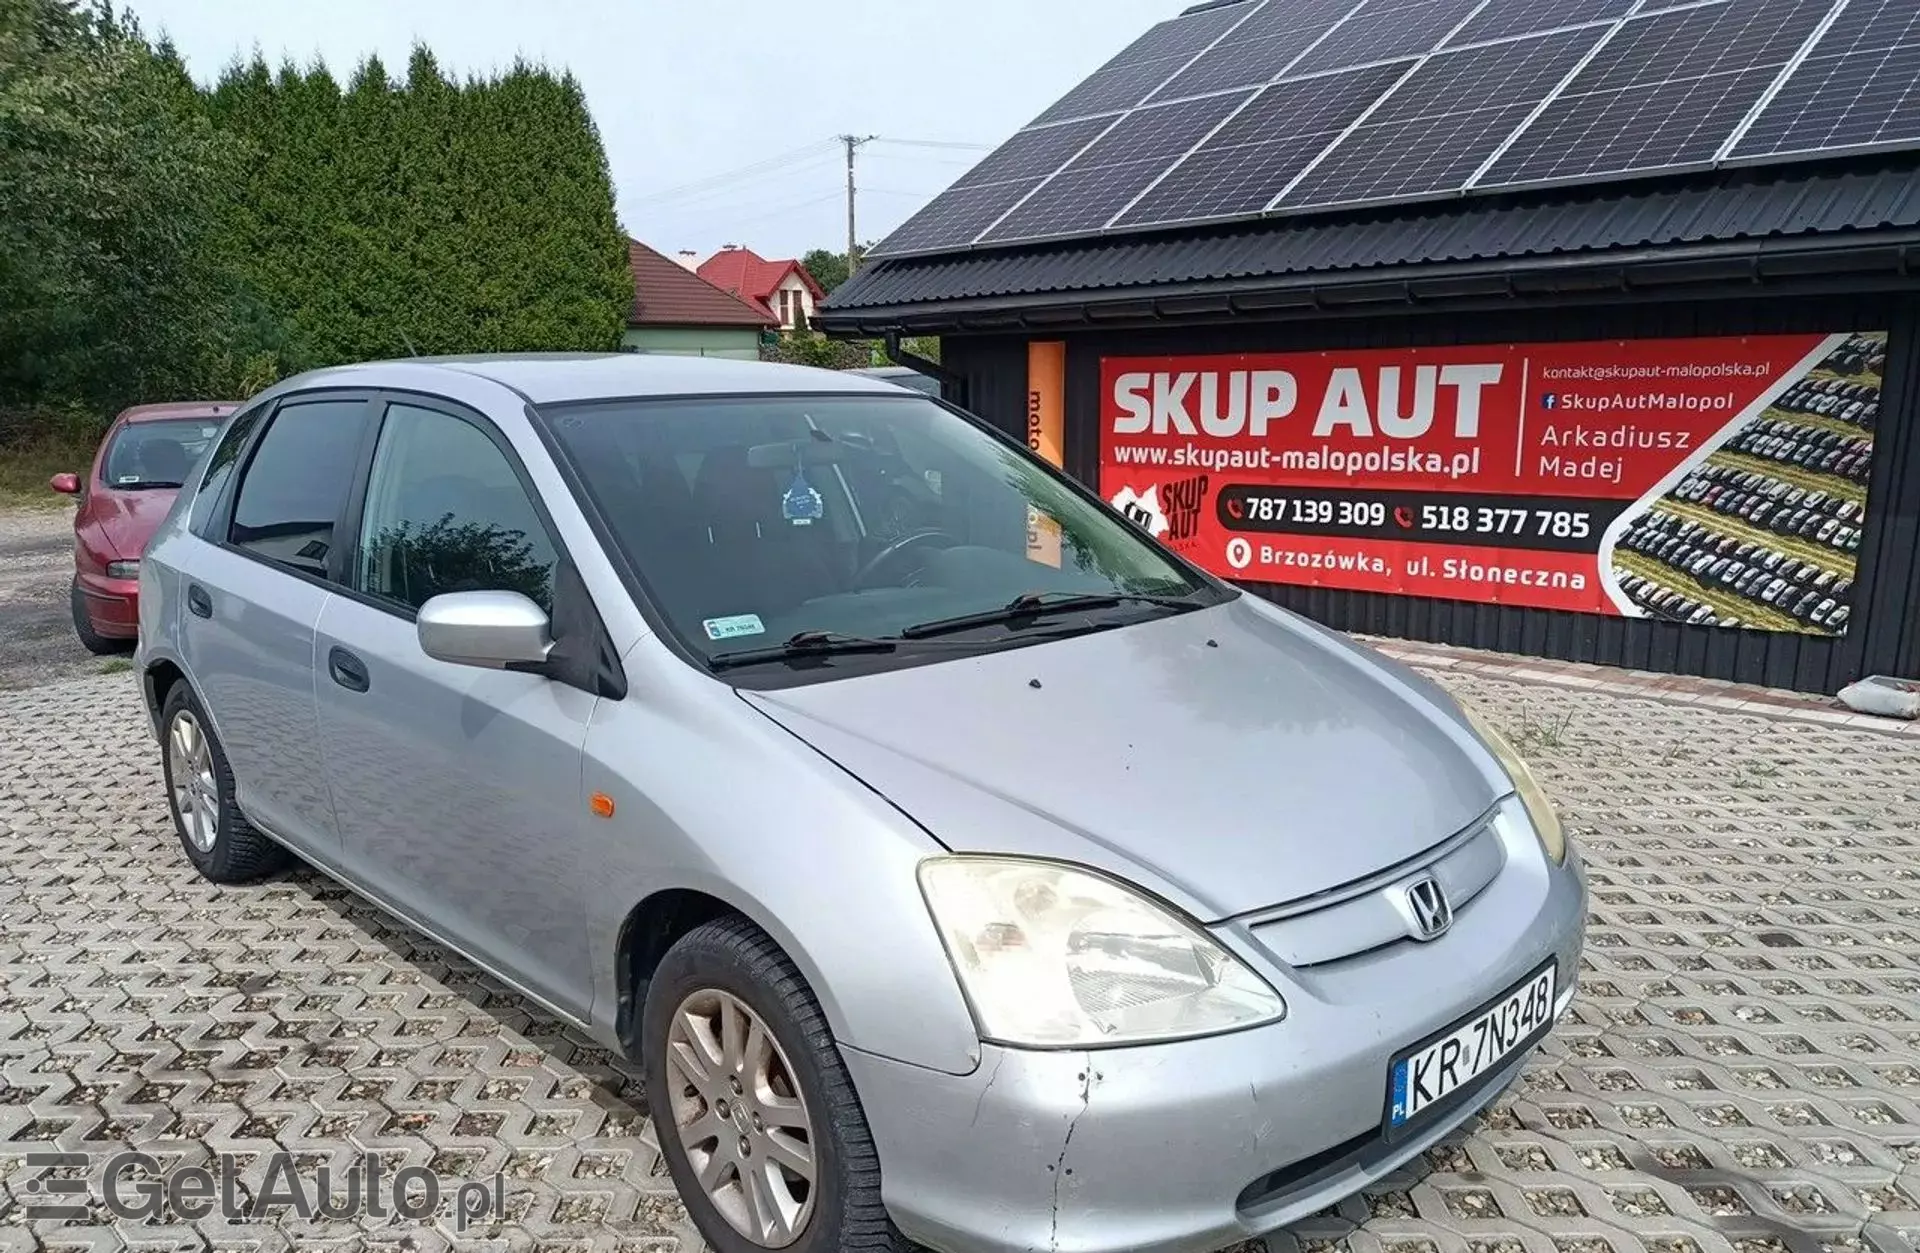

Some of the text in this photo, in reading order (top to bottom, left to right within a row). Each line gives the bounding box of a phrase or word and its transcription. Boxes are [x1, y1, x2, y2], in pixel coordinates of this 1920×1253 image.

[1543, 362, 1770, 381] kontakt@skupaut-malopolska.pl
[1113, 363, 1504, 438] SKUP AUT
[1561, 392, 1734, 412] SkupAutMalopol
[1541, 424, 1690, 449] Arkadiusz
[1114, 443, 1480, 479] www.skupaut-malopolska.pl
[1539, 455, 1623, 483] Madej
[1162, 475, 1209, 515] SKUP
[1168, 508, 1201, 541] AUT
[1246, 498, 1385, 527] 787 139 309
[1422, 504, 1590, 538] 518 377 785
[1260, 546, 1586, 590] Brzozówka, ul. Słoneczna
[1412, 975, 1548, 1111] KR 7N348
[1392, 1103, 1405, 1120] PL
